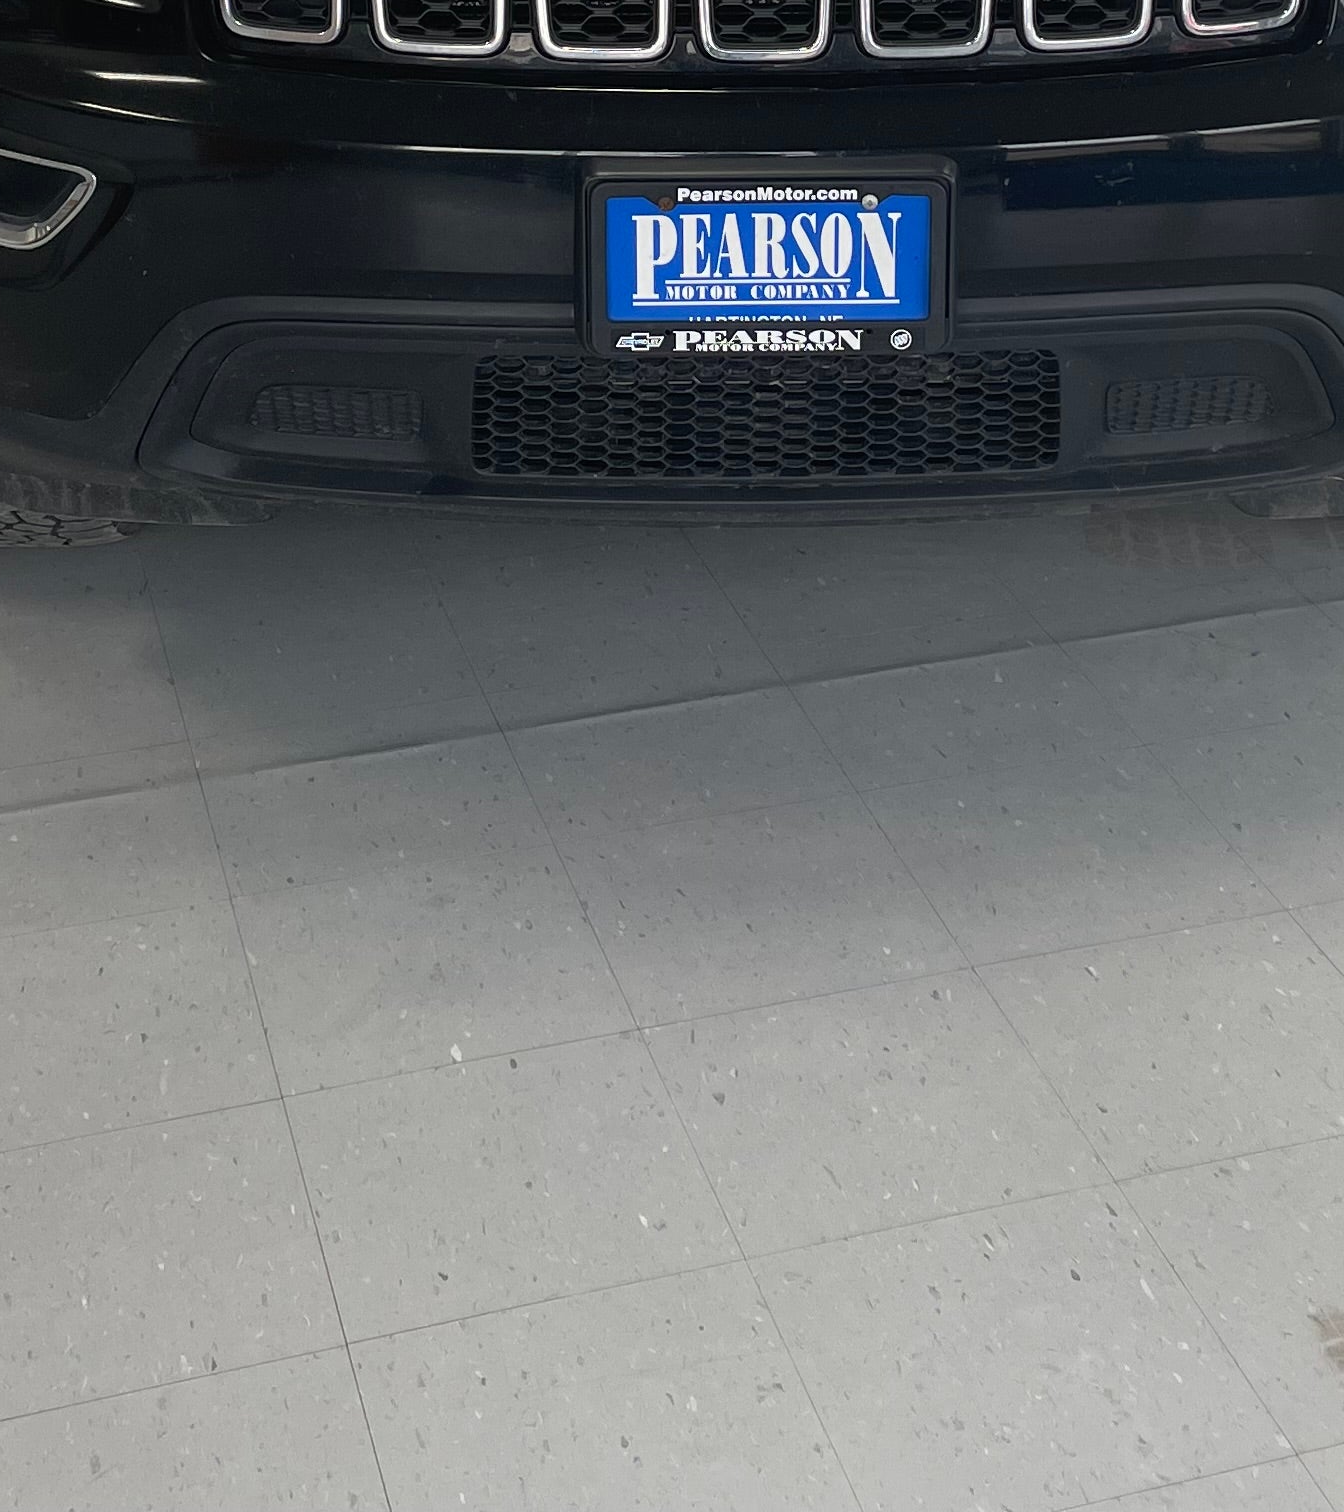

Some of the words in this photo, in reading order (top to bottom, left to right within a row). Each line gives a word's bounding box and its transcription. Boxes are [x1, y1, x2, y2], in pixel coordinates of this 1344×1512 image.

[677, 187, 858, 202] PearsonMotor.com
[632, 211, 902, 300] PEARSON
[665, 285, 738, 301] MOTOR
[750, 284, 851, 300] COMPANY
[672, 329, 864, 352] PEARSON
[695, 343, 754, 352] MOTOR
[759, 343, 840, 352] COMPANY
